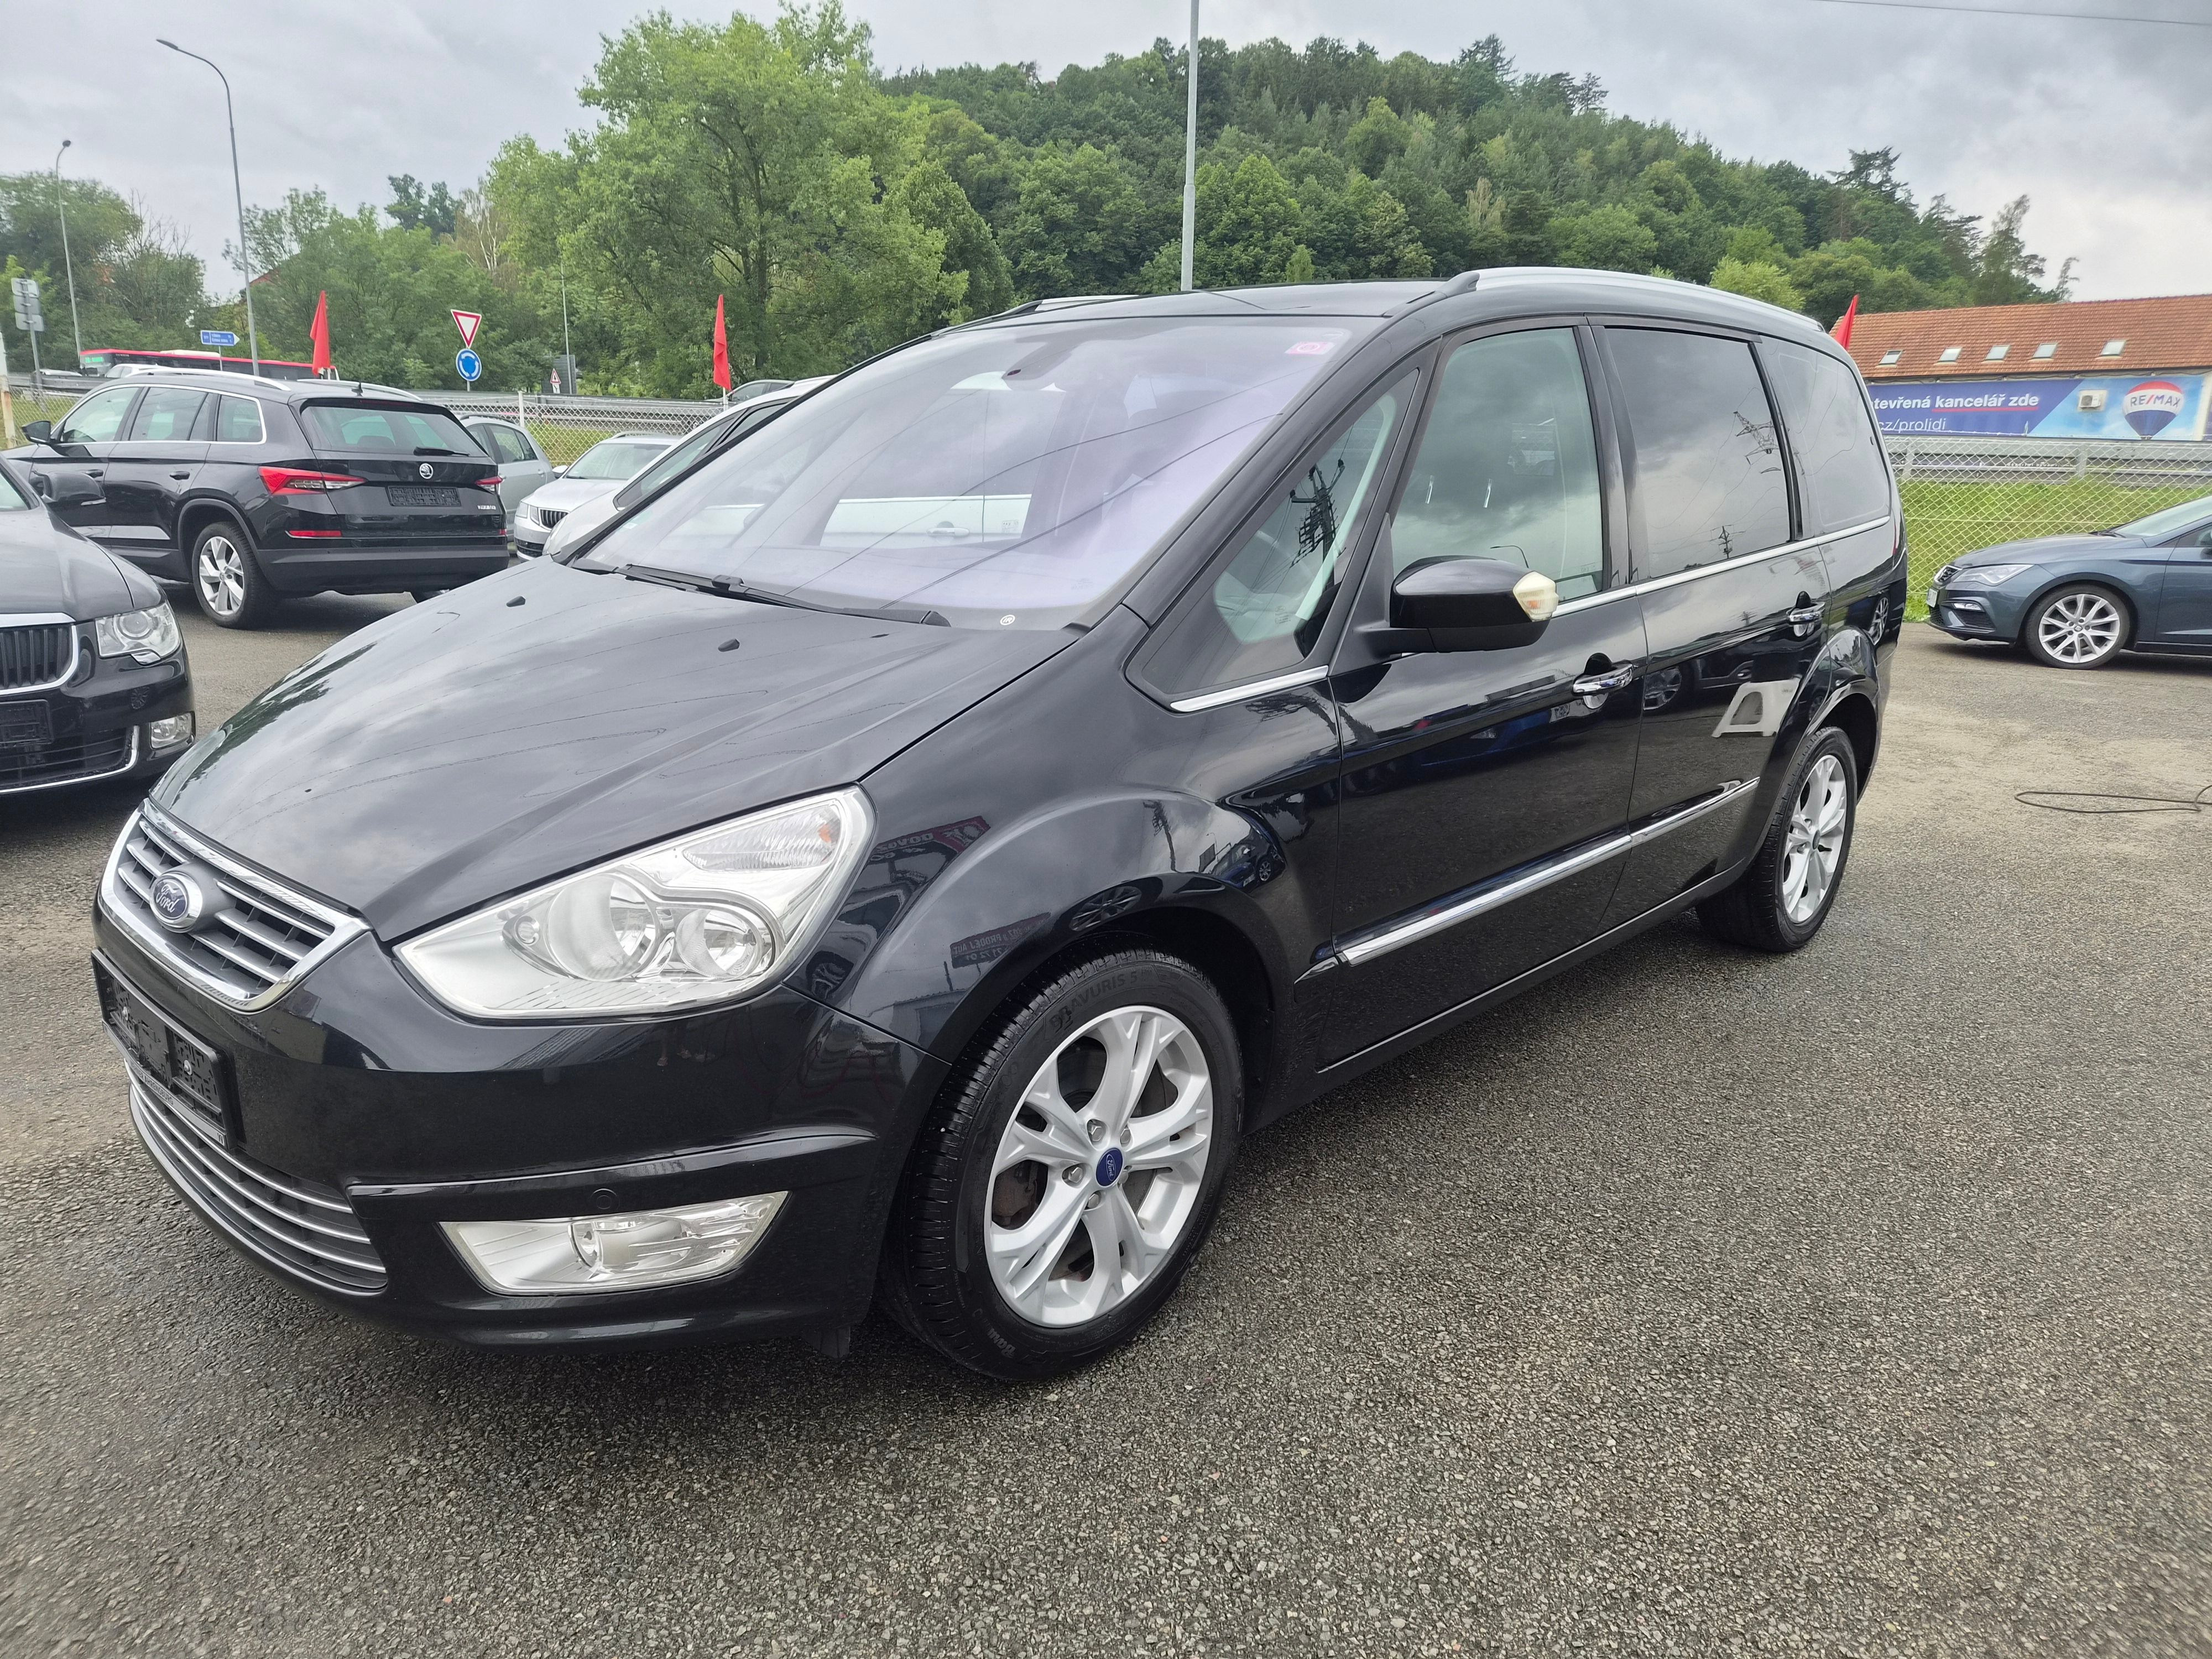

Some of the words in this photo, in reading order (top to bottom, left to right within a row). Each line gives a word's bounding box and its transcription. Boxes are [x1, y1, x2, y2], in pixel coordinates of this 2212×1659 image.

[1871, 395, 1931, 409] tevřená
[1935, 394, 2006, 408] kancelář
[2008, 393, 2039, 406] zde
[2130, 394, 2181, 408] RE/MAX
[156, 884, 180, 913] Ford
[1050, 974, 1126, 1031] BRAVURIS
